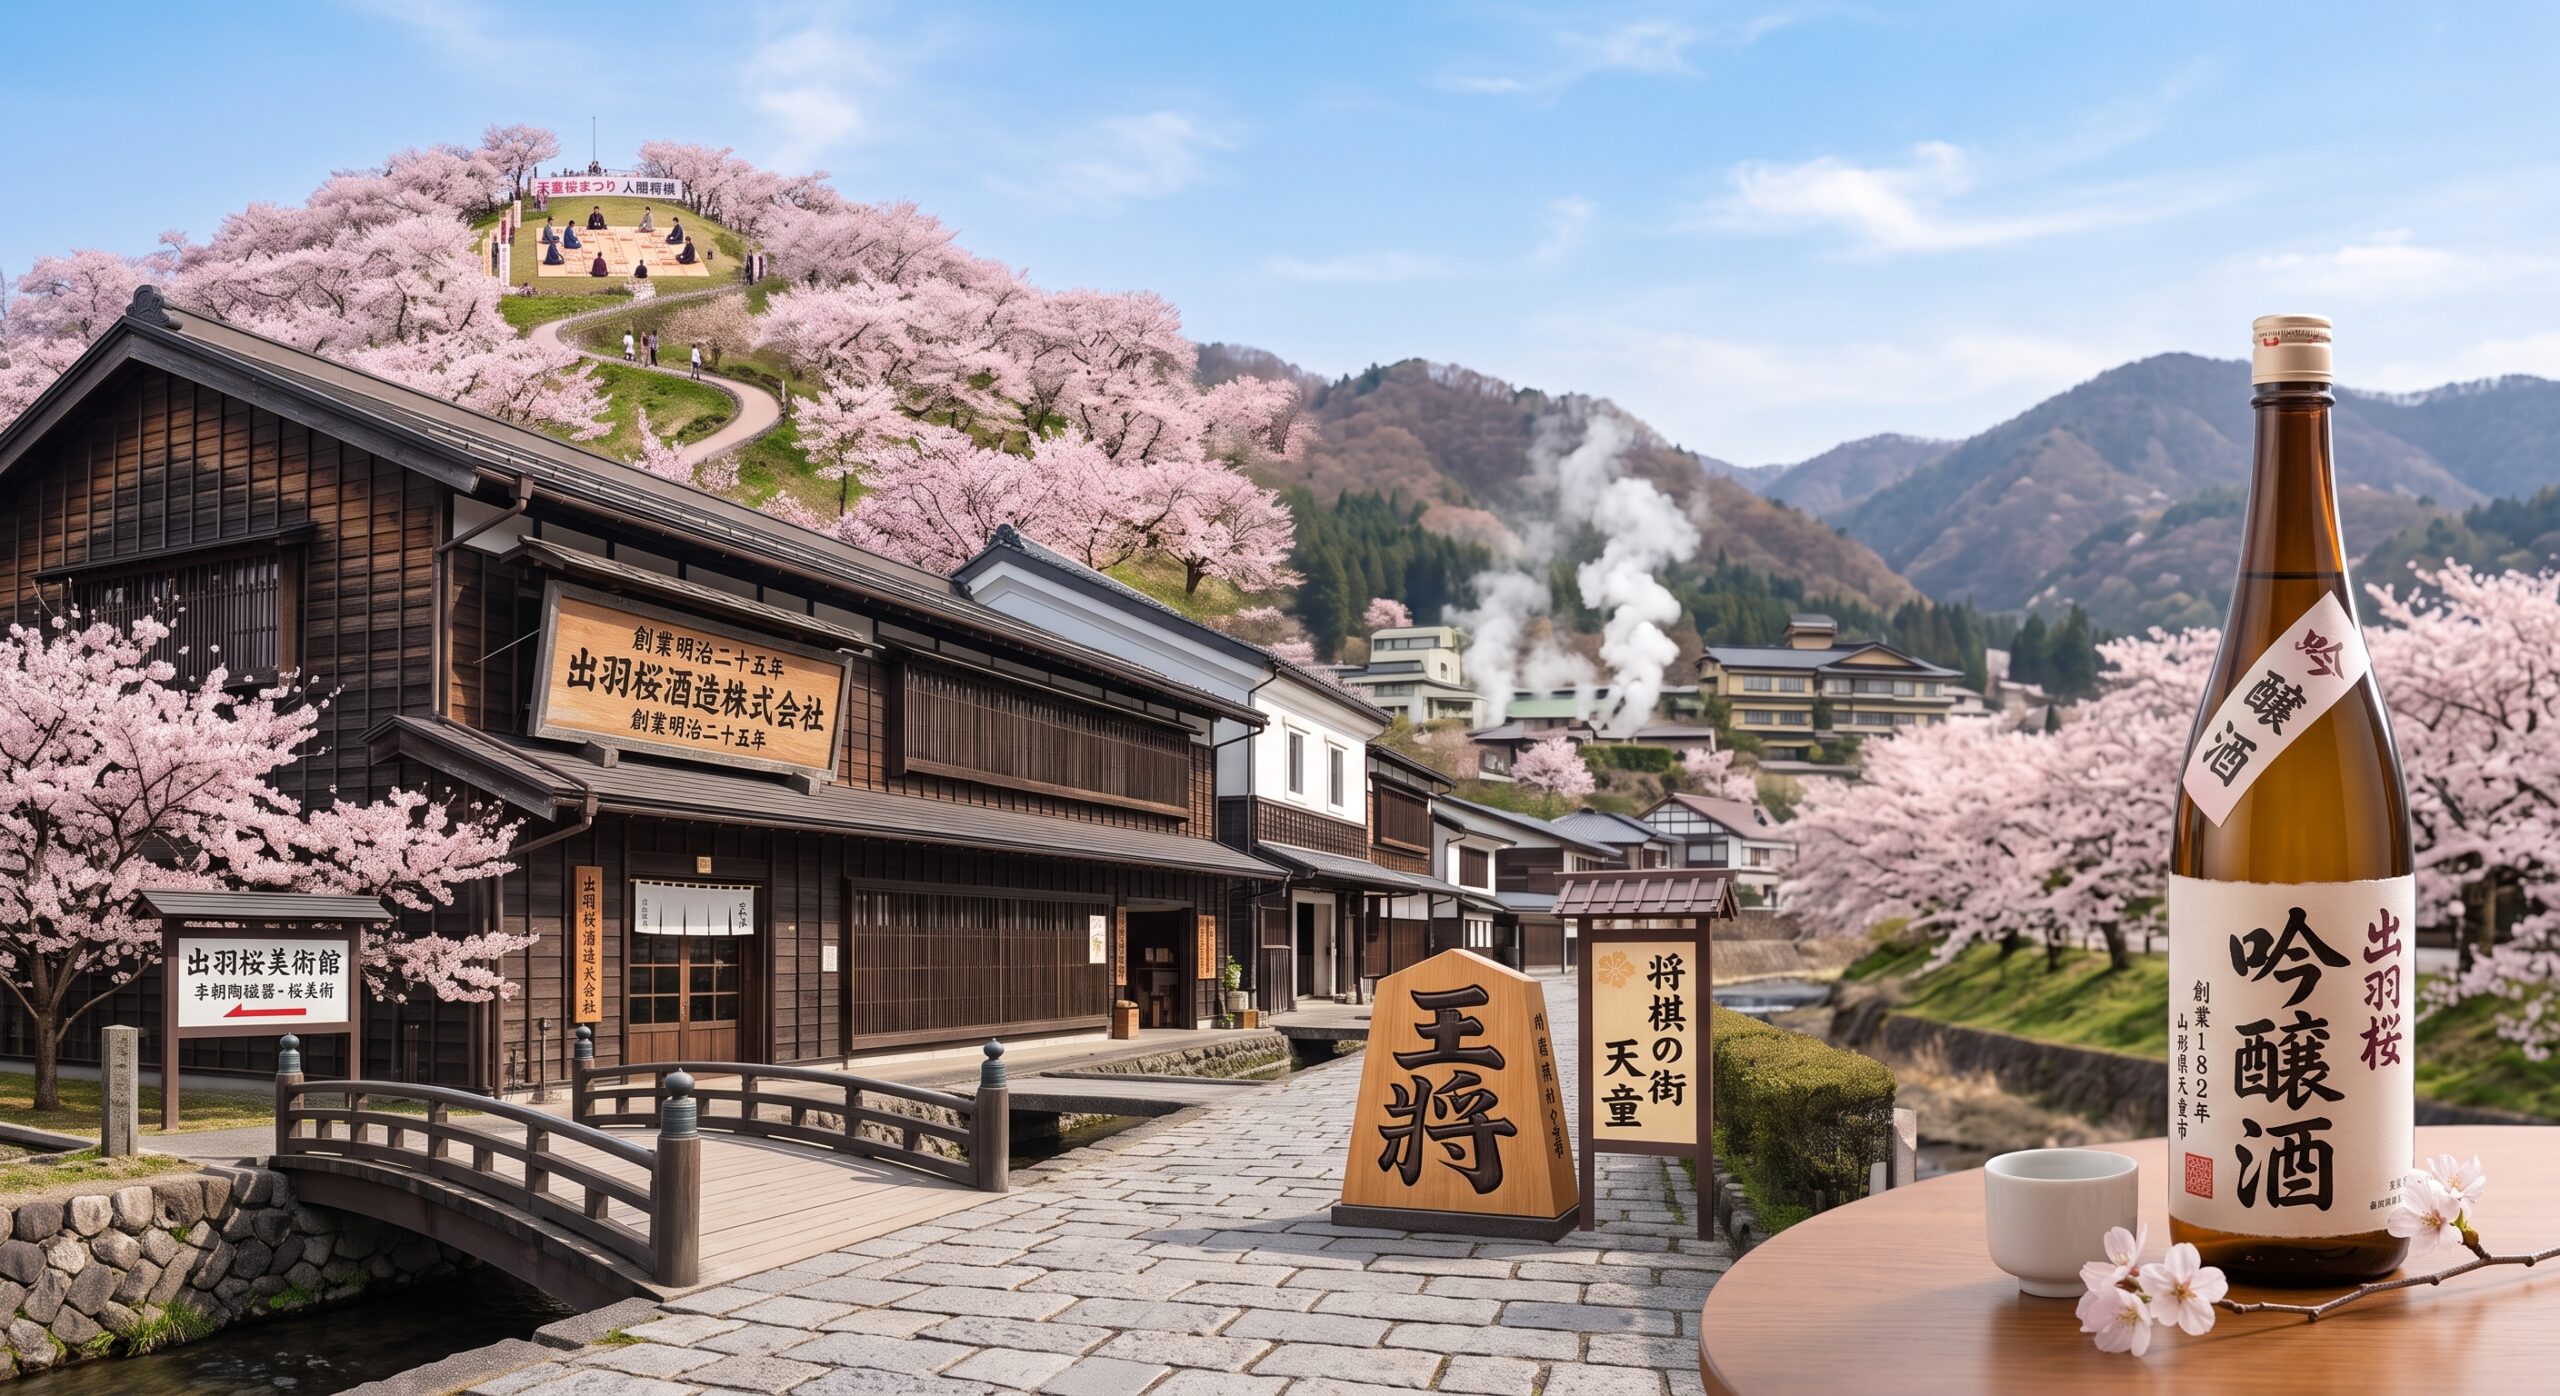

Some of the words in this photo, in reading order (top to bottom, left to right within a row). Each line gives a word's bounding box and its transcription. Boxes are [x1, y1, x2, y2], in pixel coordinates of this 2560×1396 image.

[566, 647, 824, 732] 出羽桜酒造株式会社
[632, 625, 785, 681] 創業明治二十五年
[630, 708, 766, 751] 創業明治二十五年
[187, 947, 342, 976] 出羽桜美術館
[2359, 908, 2402, 1071] 出羽桜
[1601, 1038, 1647, 1128] 天童
[1646, 952, 1687, 1107] 将棋の街
[2177, 1012, 2189, 1140] 山形県天童市
[2193, 979, 2211, 1124] 創業182年
[2229, 907, 2351, 1213] 吟醸酒
